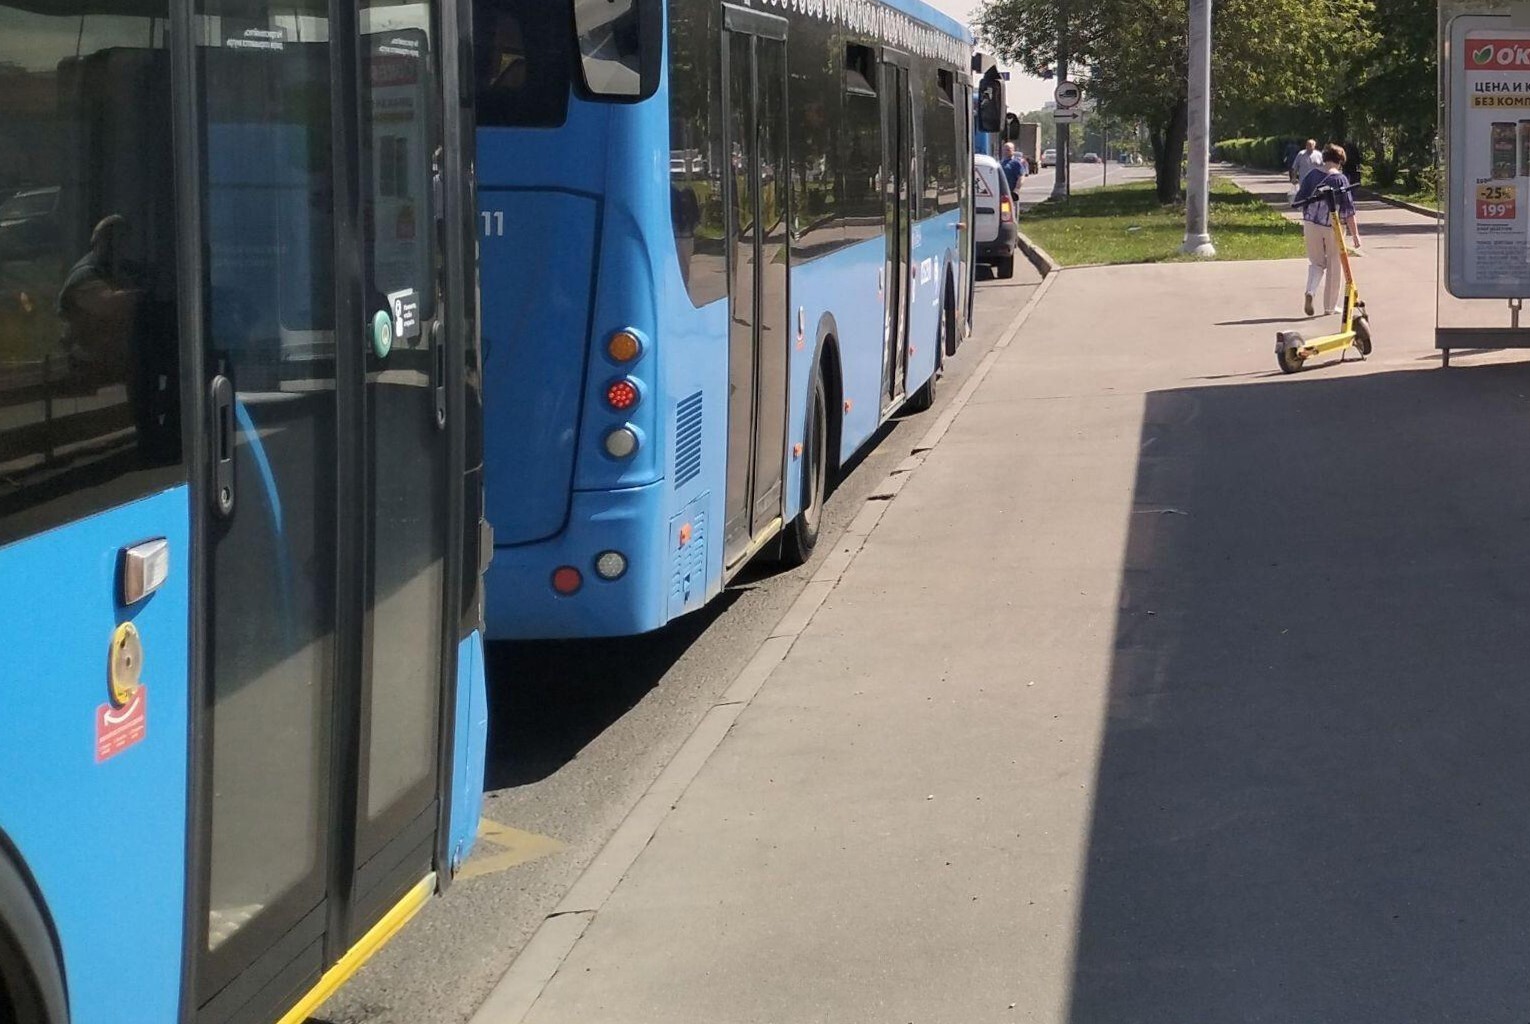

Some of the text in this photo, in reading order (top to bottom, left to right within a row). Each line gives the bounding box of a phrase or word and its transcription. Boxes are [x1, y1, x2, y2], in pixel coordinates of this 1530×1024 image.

[1475, 82, 1511, 94] ЦЕНА
[1513, 82, 1522, 93] И
[1475, 96, 1494, 107] БЕЗ
[481, 211, 504, 236] 11
